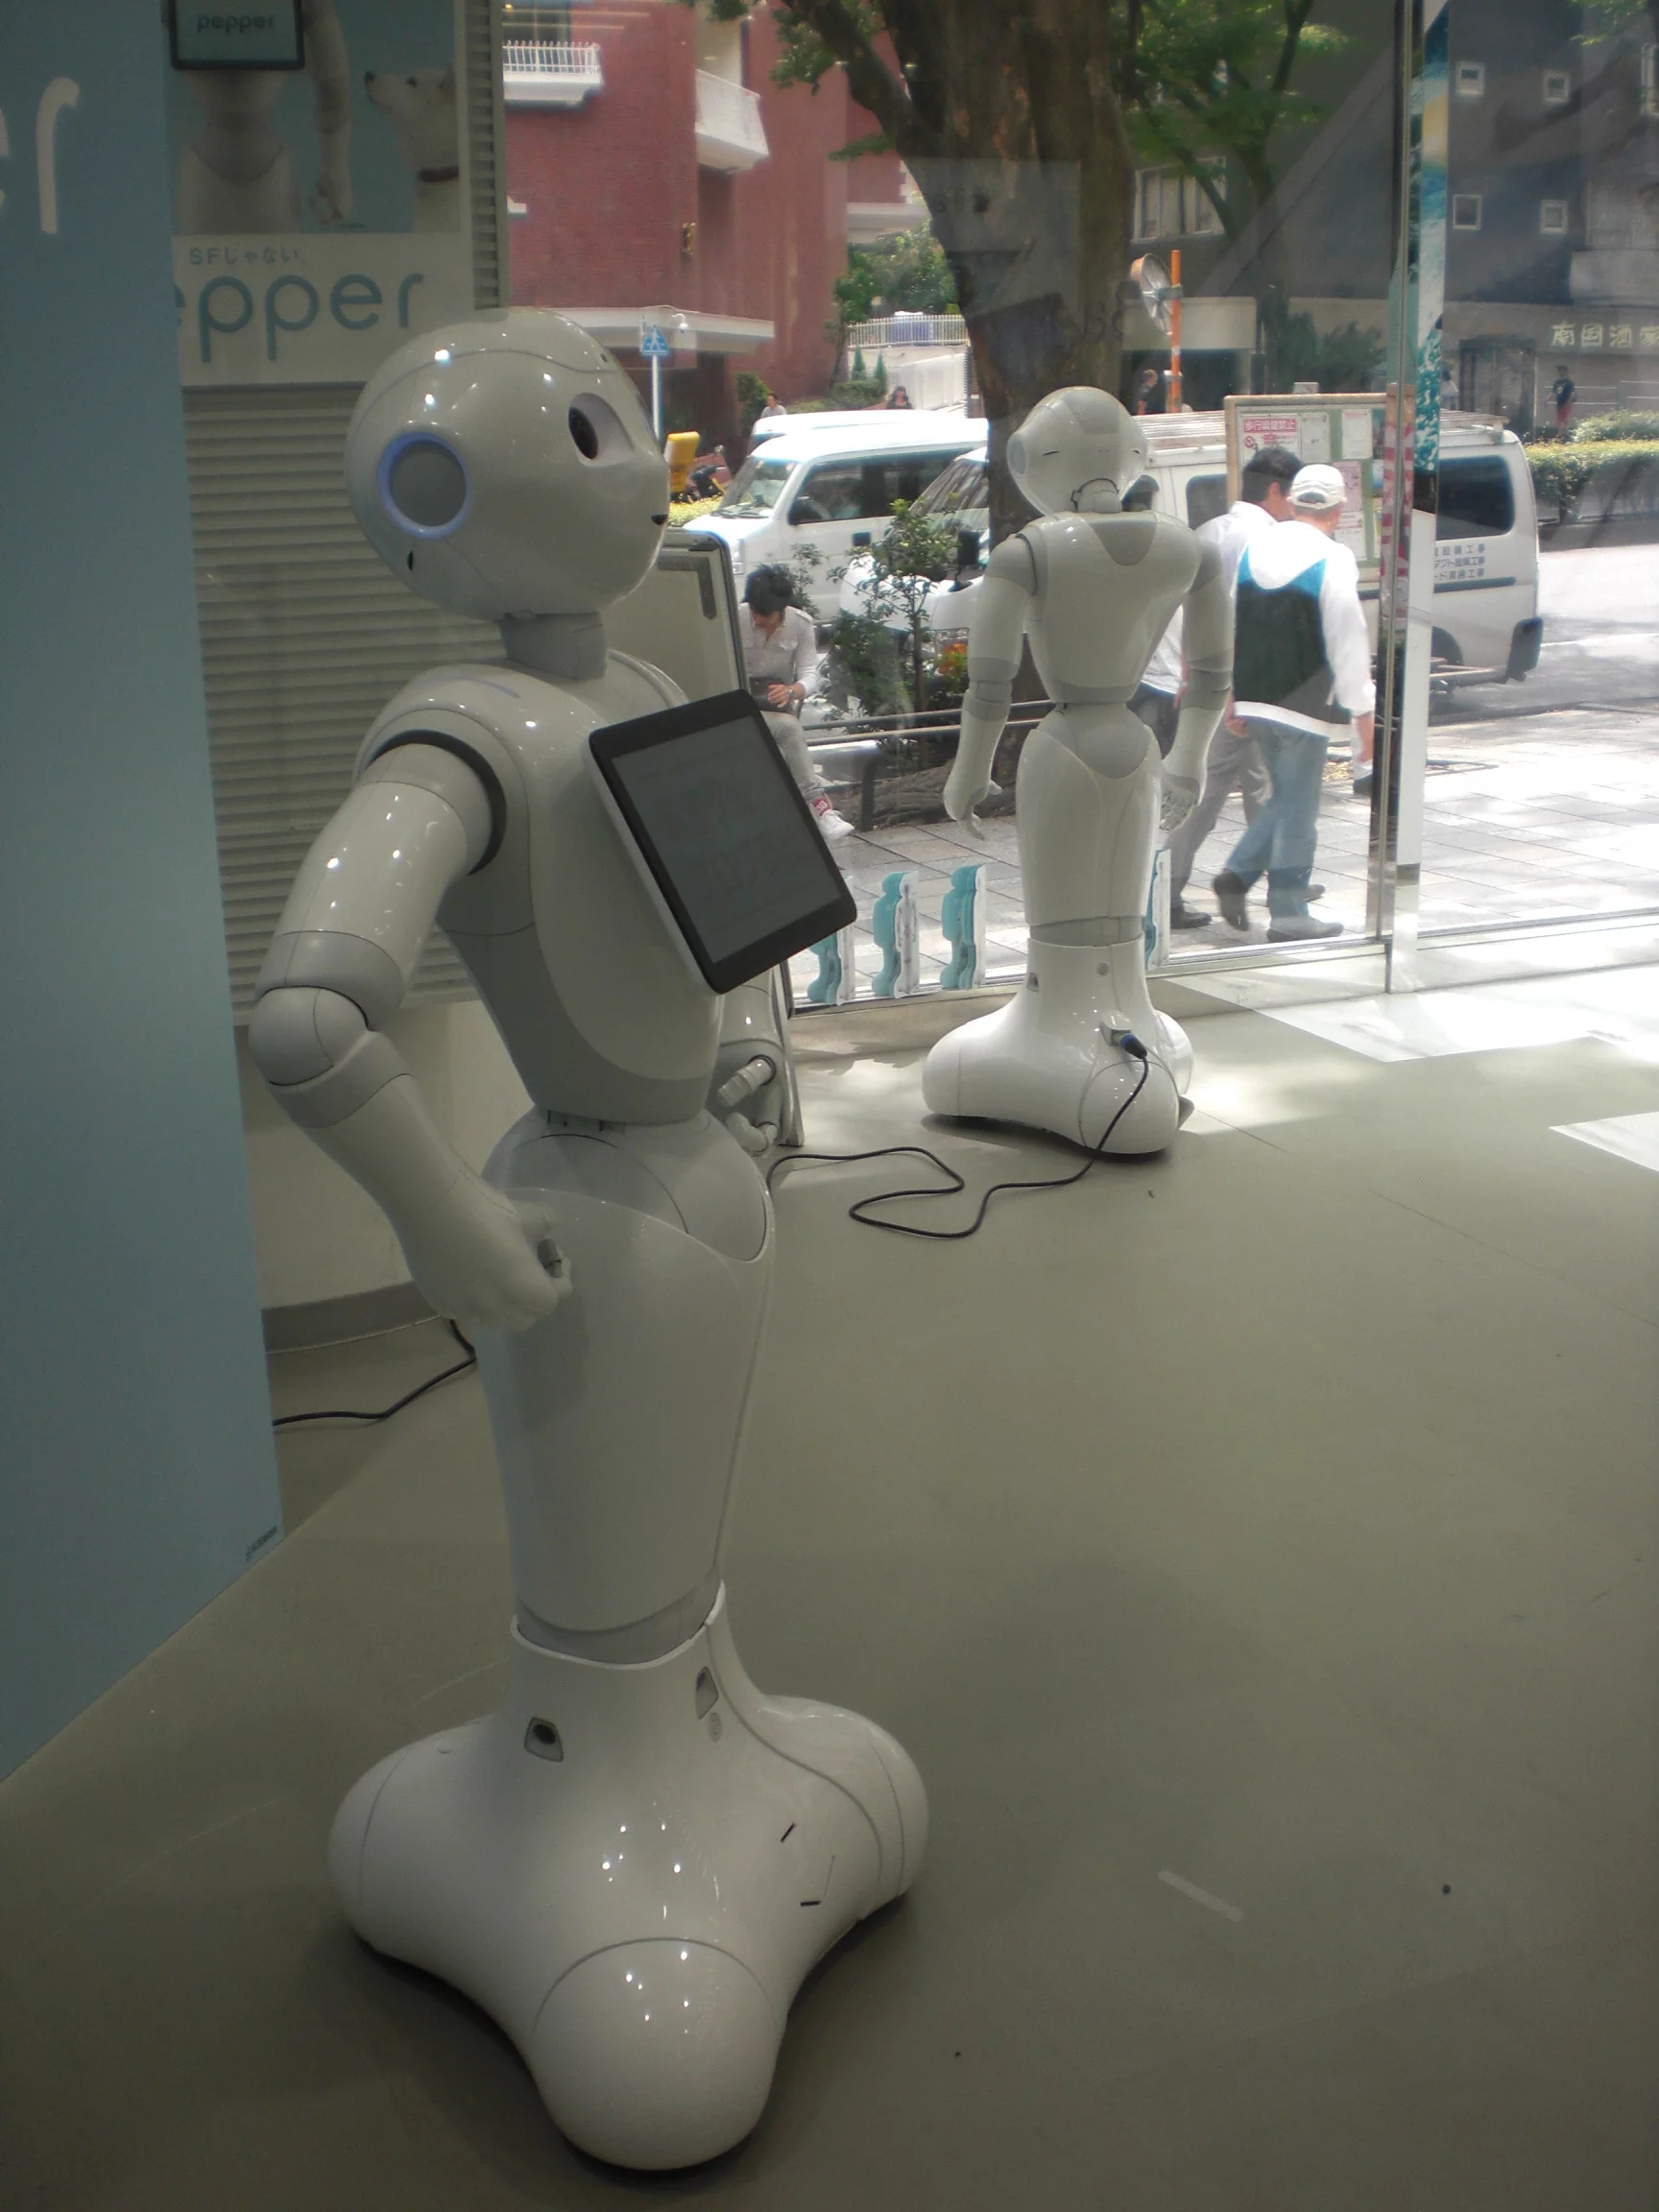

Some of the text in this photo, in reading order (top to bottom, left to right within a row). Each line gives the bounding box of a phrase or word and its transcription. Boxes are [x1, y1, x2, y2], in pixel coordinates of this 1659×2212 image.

[197, 14, 275, 34] pepper
[175, 274, 424, 363] pper
[1551, 322, 1659, 348] 南国酒家
